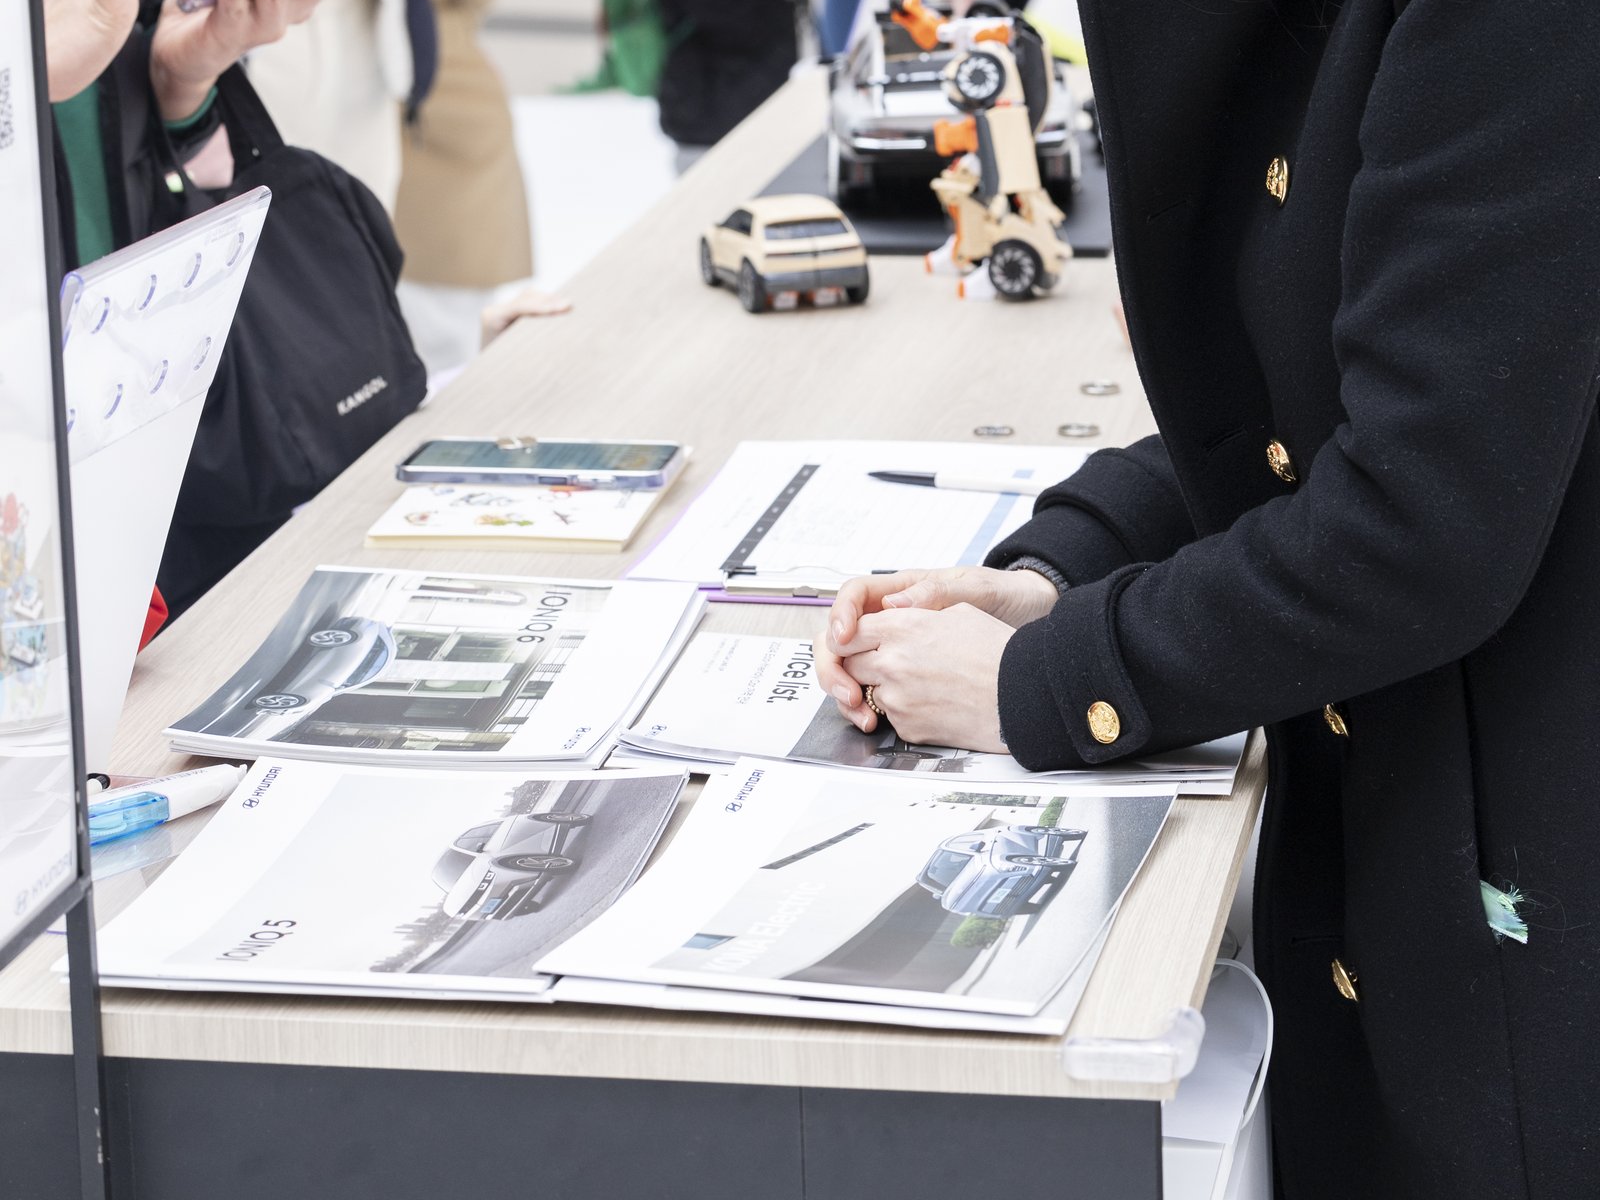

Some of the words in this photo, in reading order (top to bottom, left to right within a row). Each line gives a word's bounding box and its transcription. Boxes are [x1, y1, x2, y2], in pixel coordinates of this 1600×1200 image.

[518, 591, 572, 632] IONIQ
[517, 635, 545, 643] 6
[766, 681, 811, 703] list.
[253, 766, 282, 797] HYUNDAI
[735, 769, 765, 800] HYUNDAI
[216, 931, 294, 961] IONIQ
[262, 920, 297, 928] 5
